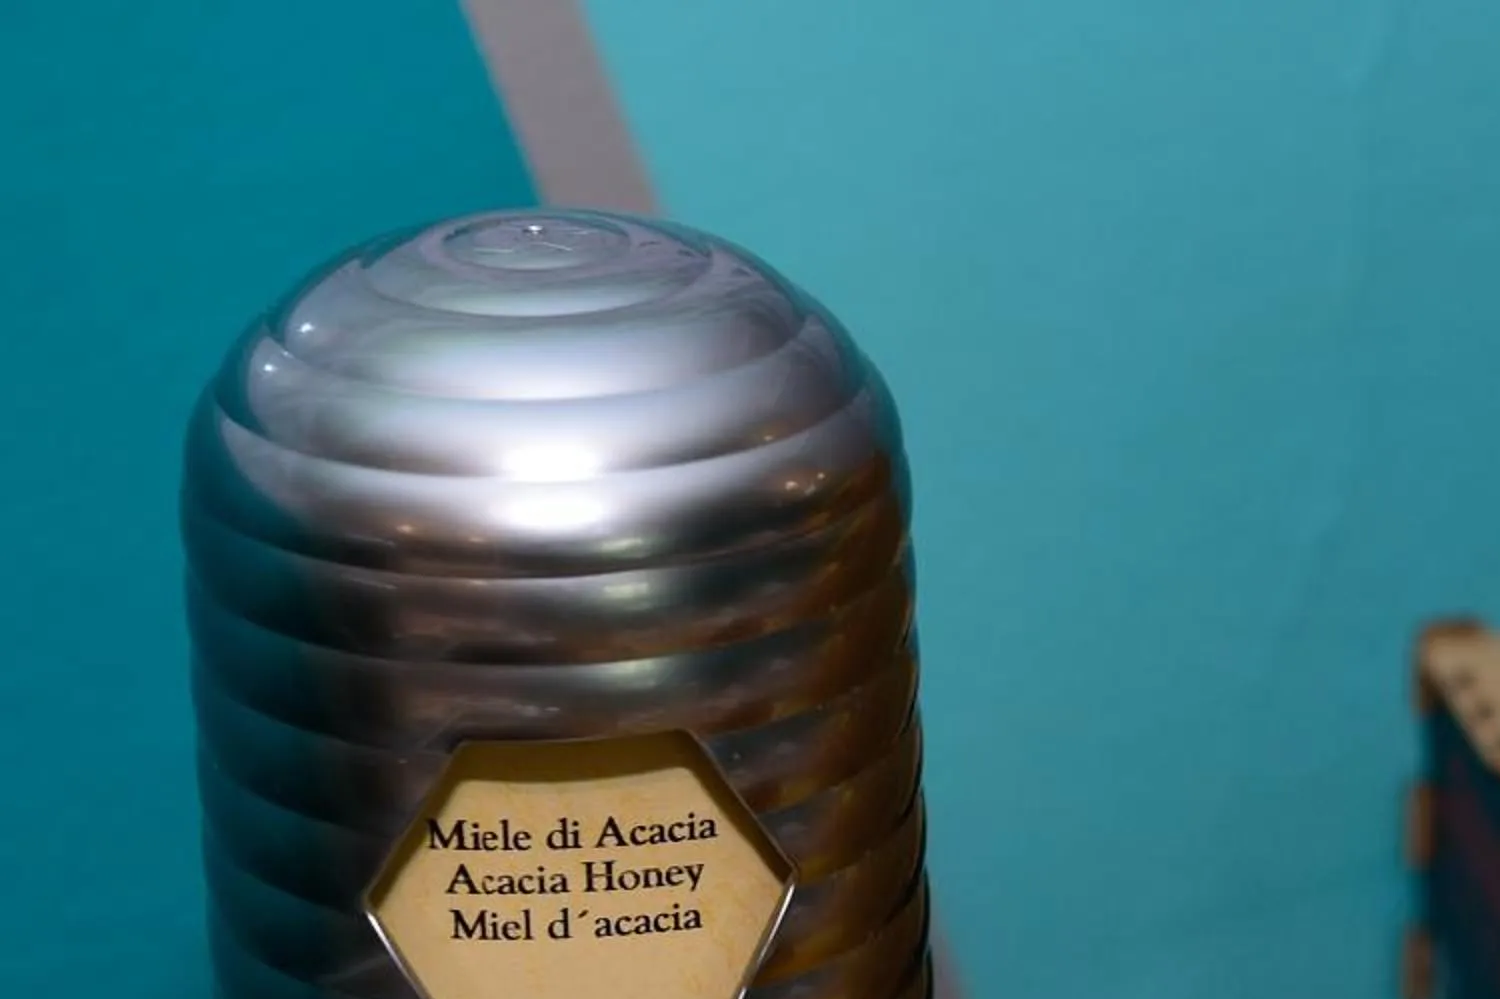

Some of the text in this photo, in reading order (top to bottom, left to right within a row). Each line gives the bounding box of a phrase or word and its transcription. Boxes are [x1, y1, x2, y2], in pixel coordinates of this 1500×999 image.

[427, 812, 718, 851] Miele di Acacia
[445, 859, 704, 895] Acacia Honey
[450, 908, 535, 941] Miel
